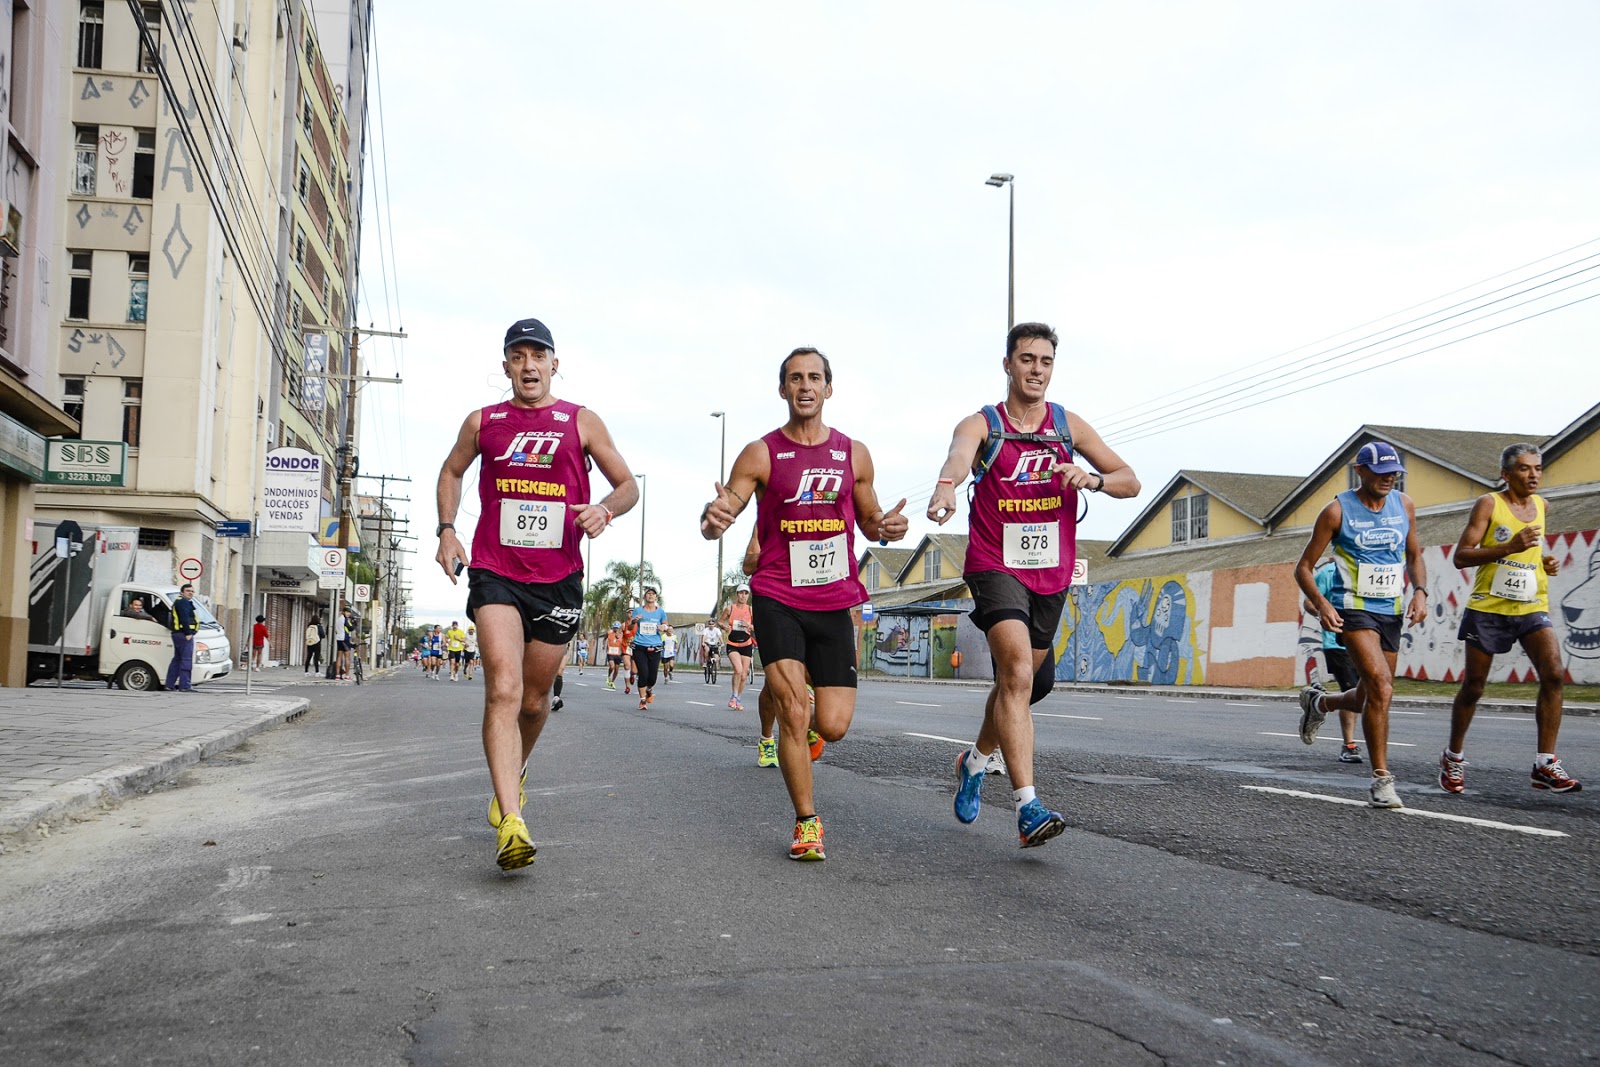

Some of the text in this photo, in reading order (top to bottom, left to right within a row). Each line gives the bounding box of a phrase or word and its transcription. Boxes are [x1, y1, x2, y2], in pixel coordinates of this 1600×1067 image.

[61, 444, 110, 464] SBS
[67, 472, 112, 482] 3228.1260
[264, 486, 318, 498] ONDOMÍNIOS
[495, 478, 567, 497] PETISKEIRA
[265, 498, 309, 510] LOCAÇÕES
[519, 504, 547, 512] CAIXA
[998, 495, 1062, 512] PETISKEIRA
[269, 510, 303, 521] VENDAS
[517, 514, 547, 531] 879
[780, 518, 846, 534] PETISKEIRA
[1022, 524, 1047, 532] CAIXA
[809, 541, 834, 551] CAIXA
[1020, 535, 1049, 550] 878
[330, 554, 336, 563] E
[808, 551, 836, 569] 877
[1368, 573, 1397, 586] 1417
[1504, 578, 1527, 590] 441
